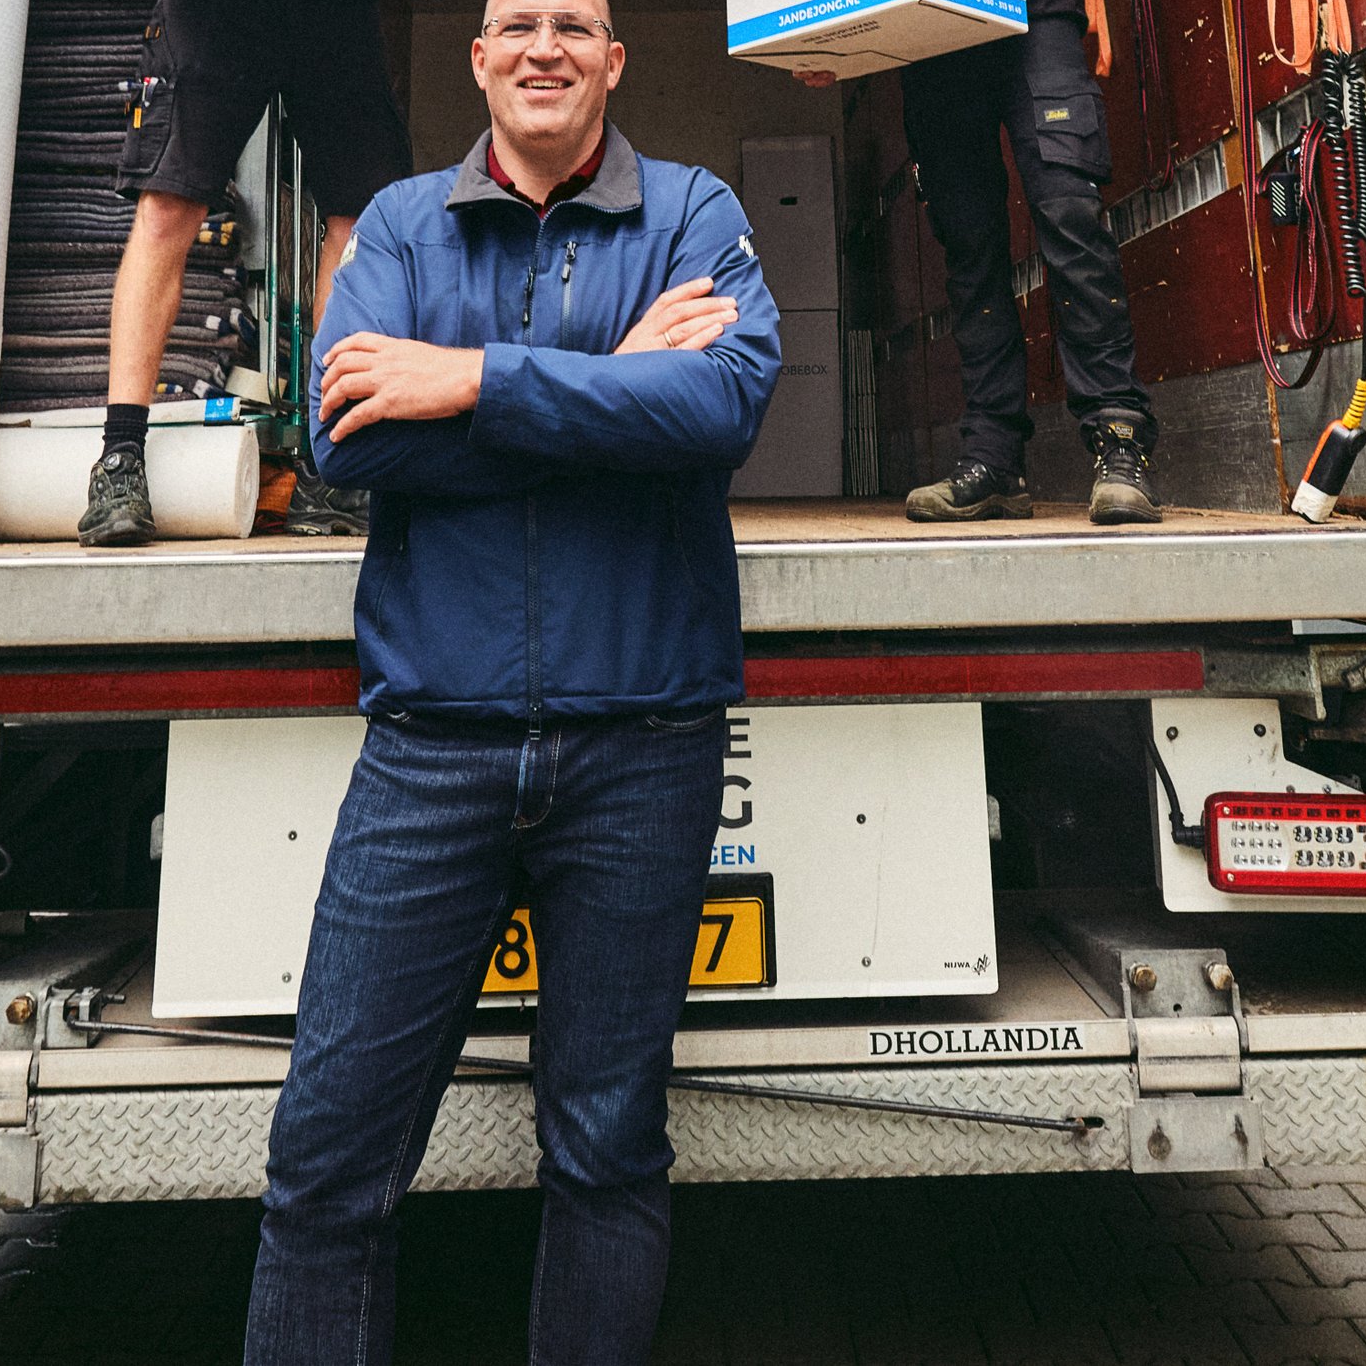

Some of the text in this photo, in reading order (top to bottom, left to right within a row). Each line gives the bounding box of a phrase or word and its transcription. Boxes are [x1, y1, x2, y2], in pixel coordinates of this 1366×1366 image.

[781, 365, 828, 375] OBEBOX
[724, 718, 752, 758] E
[719, 775, 753, 829] G
[709, 845, 756, 865] GEN
[870, 1027, 1083, 1055] DHOLLANDIA
